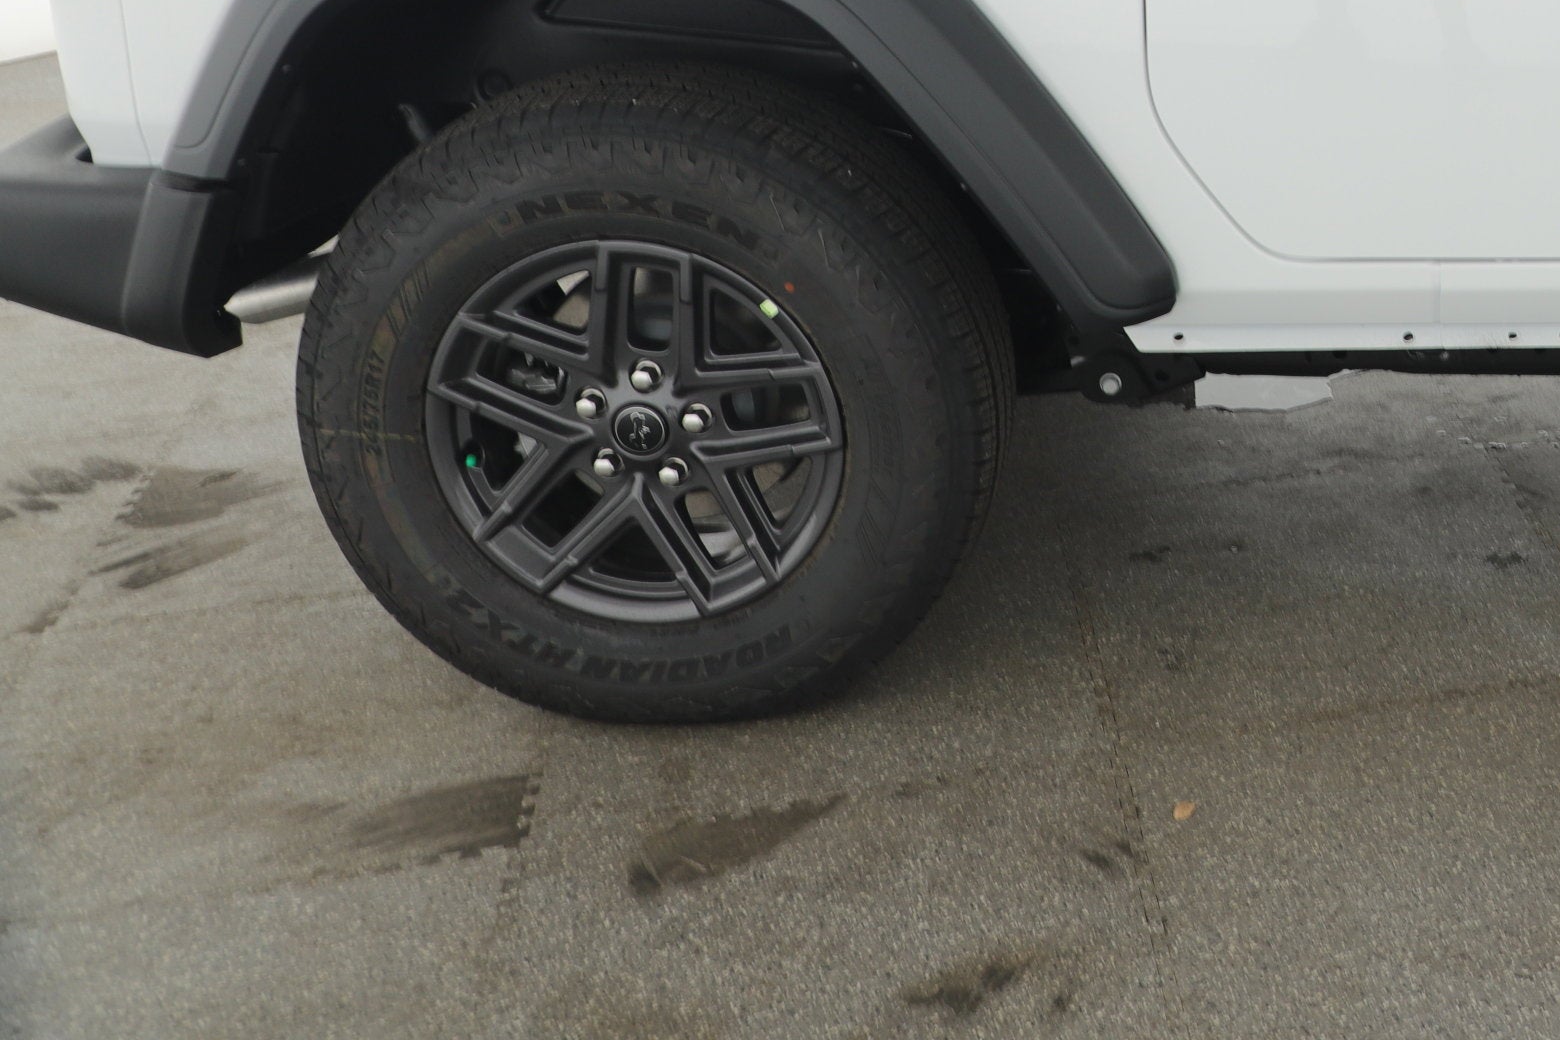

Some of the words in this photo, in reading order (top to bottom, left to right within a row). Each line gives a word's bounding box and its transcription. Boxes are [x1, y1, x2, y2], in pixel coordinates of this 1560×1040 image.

[514, 189, 761, 248] NEXEN
[361, 348, 386, 458] 245/75R17
[579, 622, 794, 686] ROADIAN
